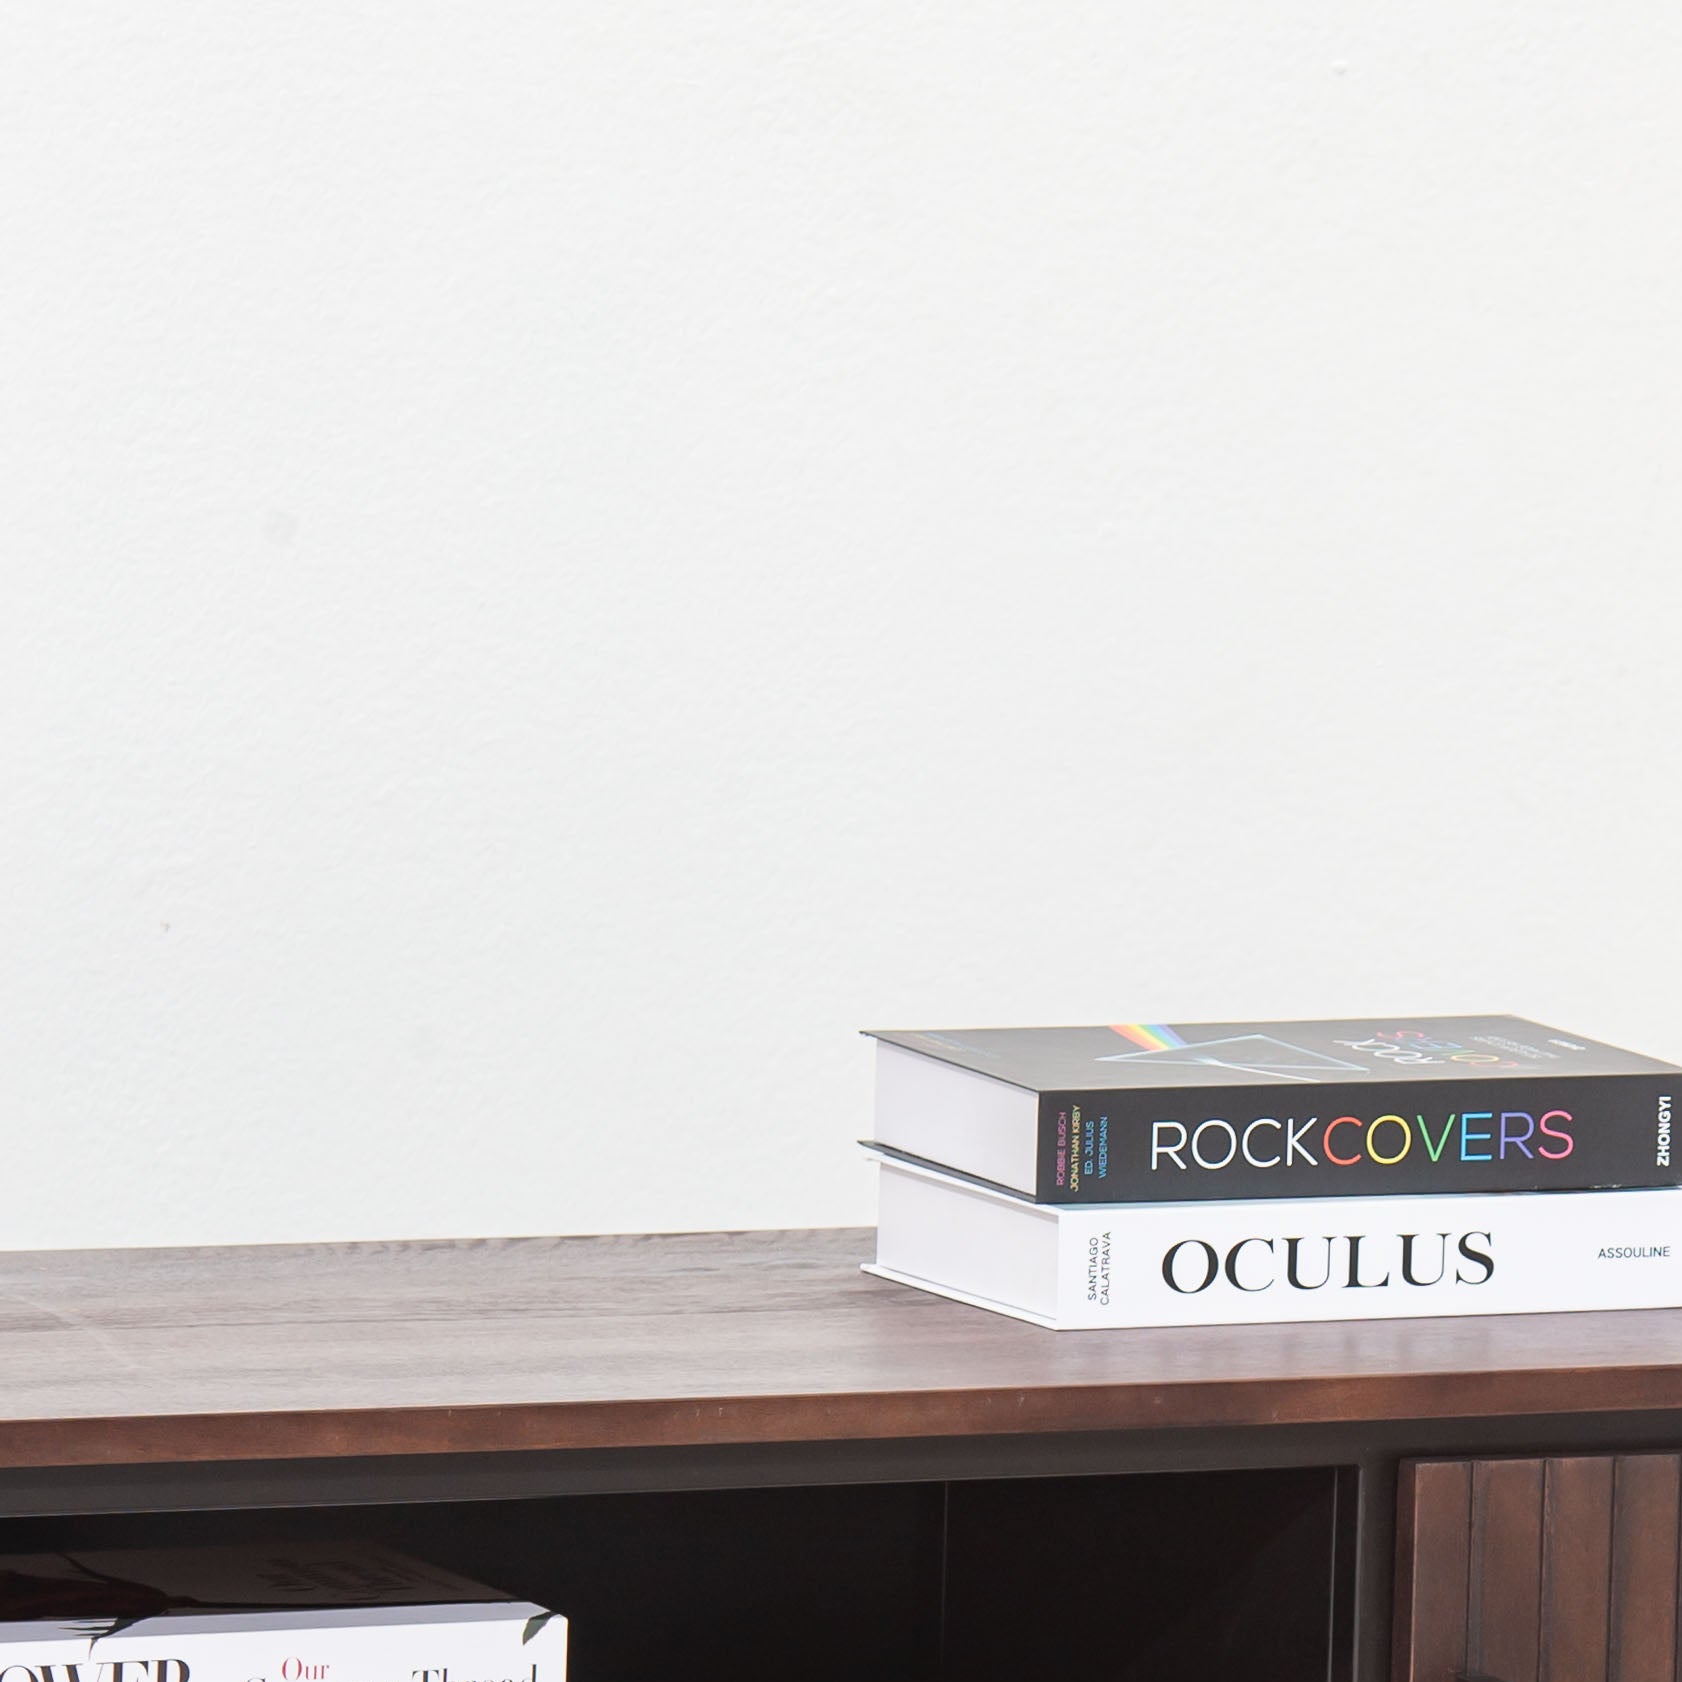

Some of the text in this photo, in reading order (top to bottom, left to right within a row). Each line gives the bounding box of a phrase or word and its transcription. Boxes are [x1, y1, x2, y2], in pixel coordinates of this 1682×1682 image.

[1056, 1111, 1067, 1186] ROBBIE BUSCH
[1070, 1104, 1081, 1192] JONATHAN KIRBY
[1084, 1121, 1095, 1175] ED. JULIUS
[1098, 1116, 1108, 1179] WIEDEMANN
[1656, 1096, 1672, 1167] ZHONGYI
[1087, 1237, 1099, 1301] SANTIAGO
[1099, 1231, 1112, 1306] CALATRAVA
[1161, 1231, 1495, 1295] OCULUS
[1597, 1246, 1671, 1259] ASSOULINE
[281, 1657, 330, 1682] Our
